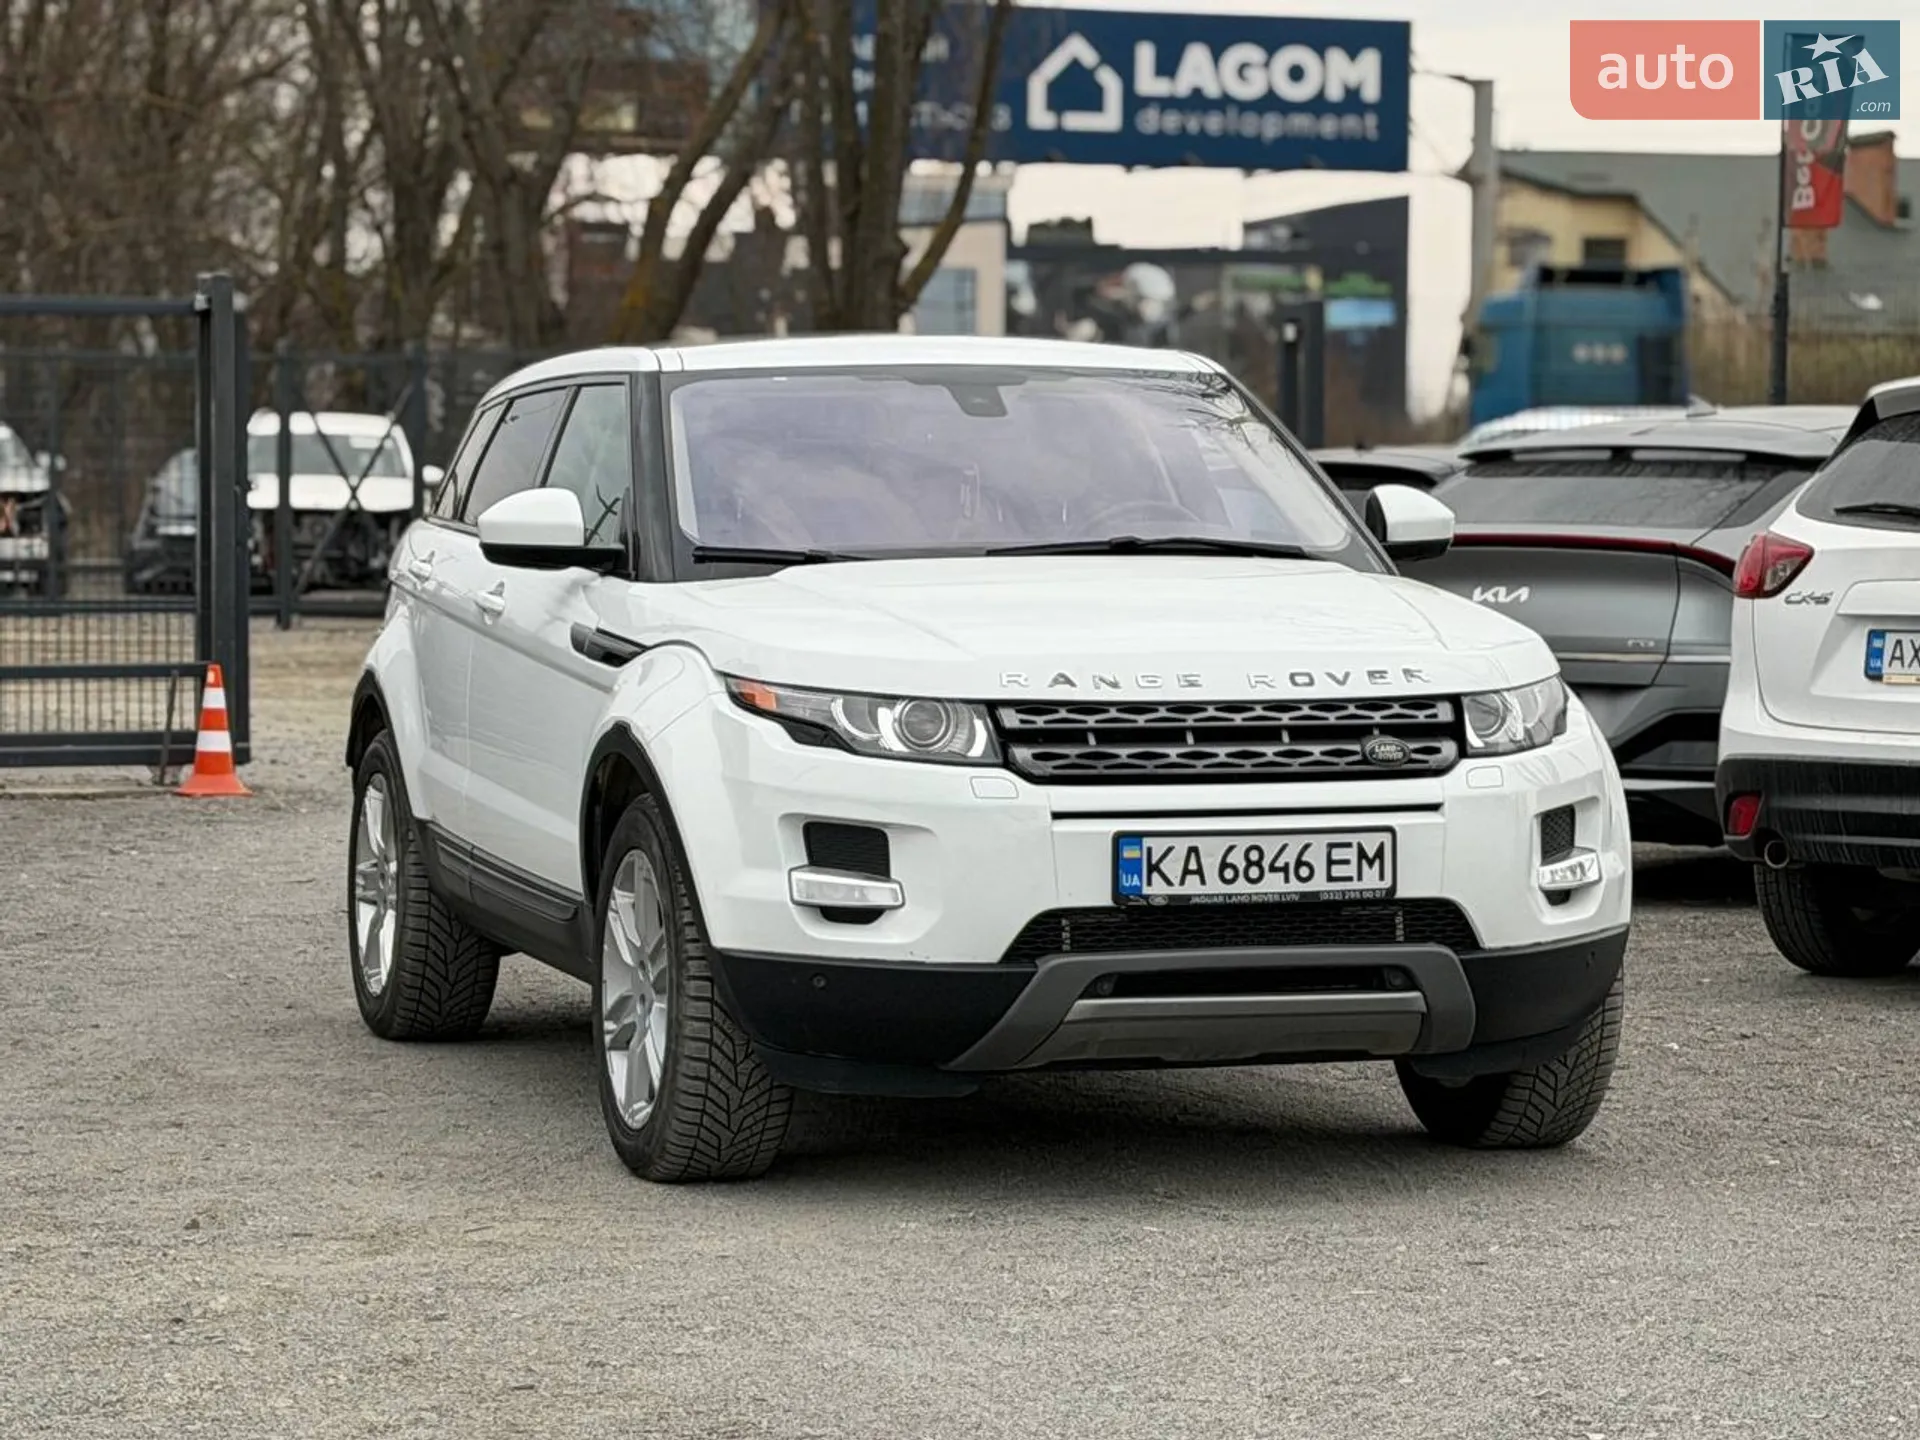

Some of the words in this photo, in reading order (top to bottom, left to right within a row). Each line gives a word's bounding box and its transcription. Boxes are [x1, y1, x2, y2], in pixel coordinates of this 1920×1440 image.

[1134, 40, 1382, 103] LAGOM
[1135, 103, 1380, 143] development
[1473, 586, 1530, 603] KIA
[999, 671, 1202, 689] RANGE
[1247, 667, 1431, 688] ROVER
[1146, 845, 1206, 887] KA
[1218, 842, 1315, 885] 6846
[1326, 840, 1385, 883] EM
[1122, 873, 1141, 887] UA
